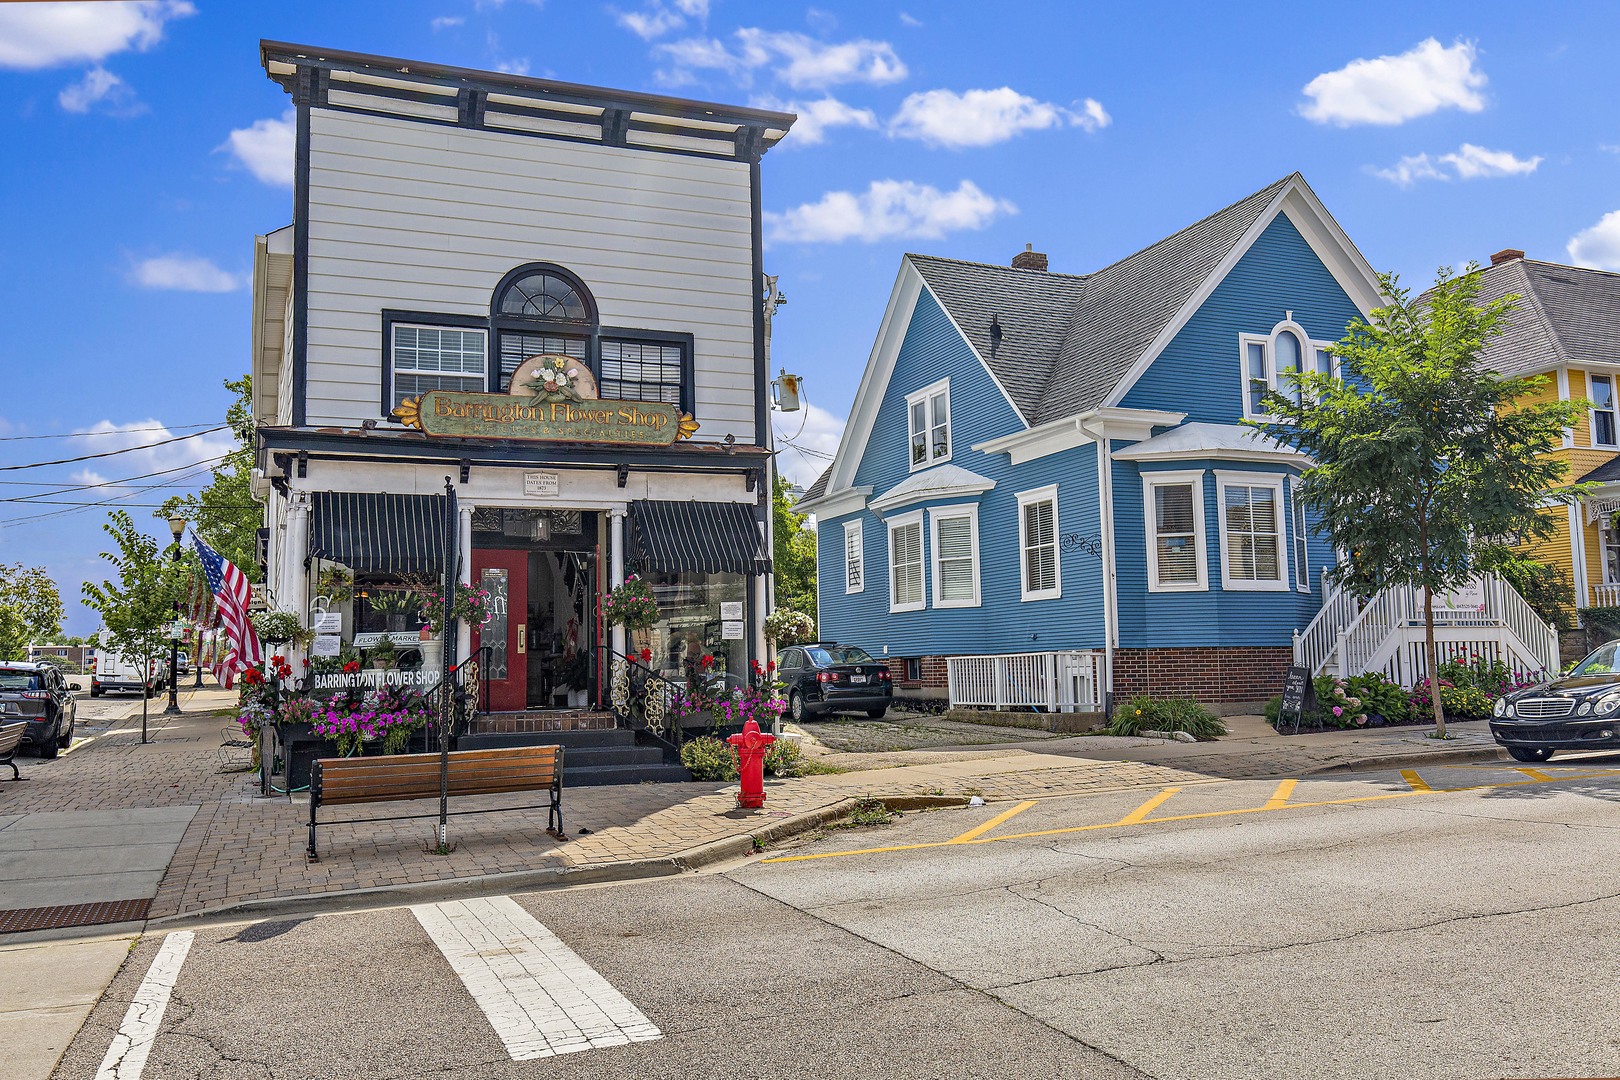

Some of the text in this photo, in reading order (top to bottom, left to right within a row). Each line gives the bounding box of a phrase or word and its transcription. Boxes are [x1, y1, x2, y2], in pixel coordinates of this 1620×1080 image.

[434, 396, 669, 432] Barrington Flower Shop
[543, 426, 551, 434] &
[557, 426, 647, 439] SPECIALTIES
[314, 670, 440, 689] BARRINGTON FLOWER SHOP
